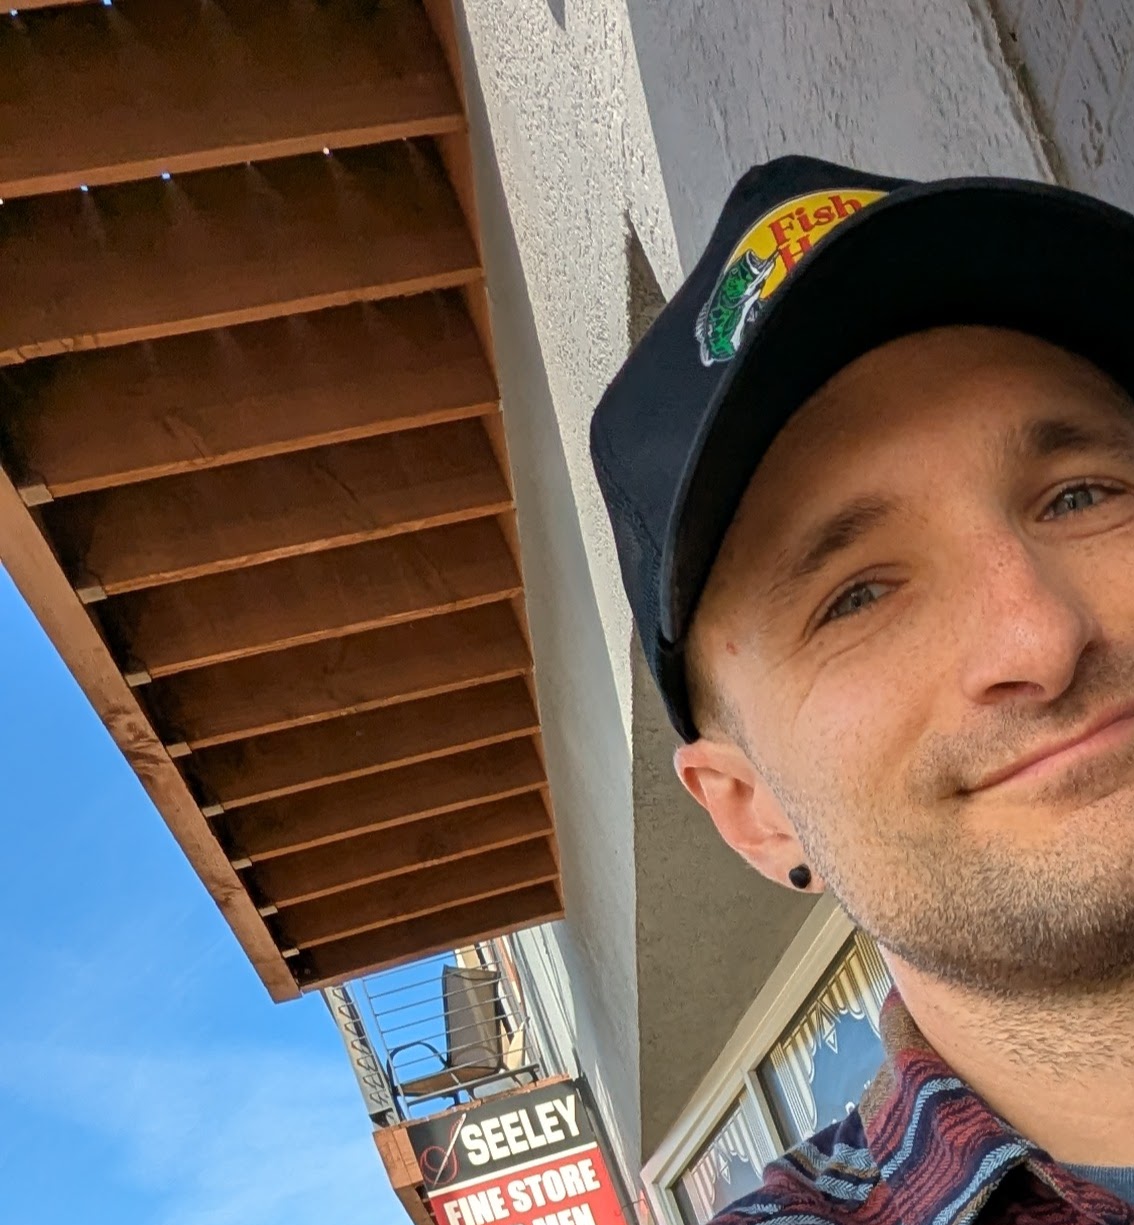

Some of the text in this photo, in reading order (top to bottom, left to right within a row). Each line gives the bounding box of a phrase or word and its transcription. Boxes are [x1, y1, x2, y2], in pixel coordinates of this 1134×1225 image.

[768, 195, 863, 246] Fish
[460, 1095, 580, 1167] SEELEY
[507, 1158, 601, 1214] STORE
